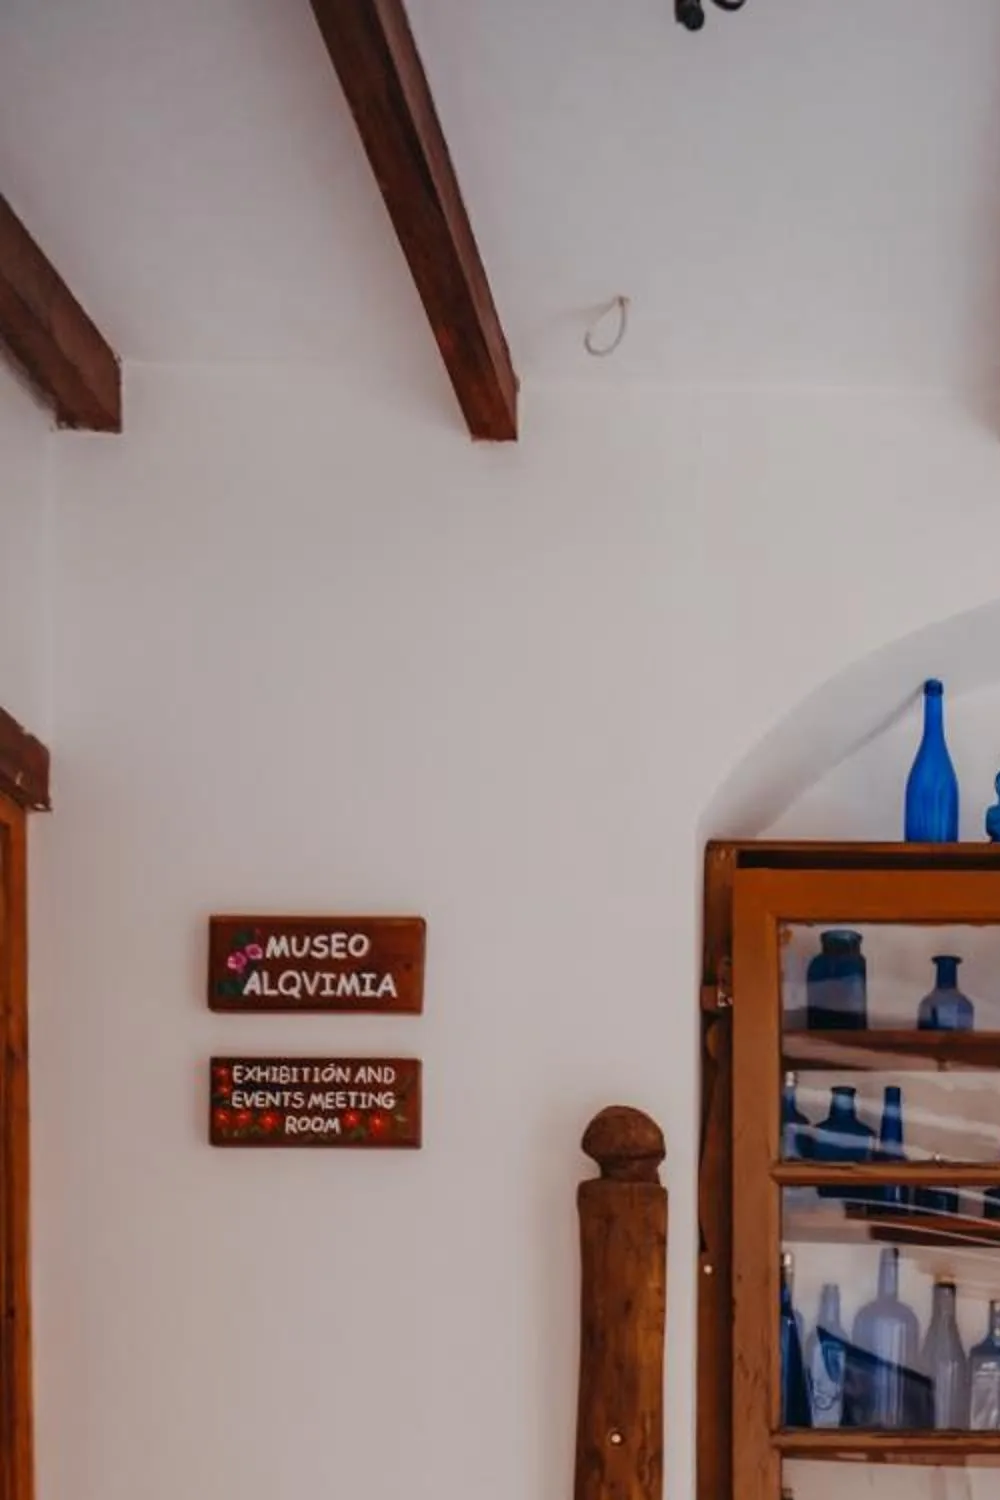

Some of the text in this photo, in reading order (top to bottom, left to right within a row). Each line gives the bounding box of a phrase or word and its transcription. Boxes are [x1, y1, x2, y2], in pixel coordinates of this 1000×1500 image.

[266, 932, 370, 959] MUSEO
[242, 970, 398, 998] ALQVIMIA
[354, 1066, 396, 1084] AND
[231, 1090, 396, 1110] EVENTS MEETING
[284, 1115, 341, 1134] ROOM
